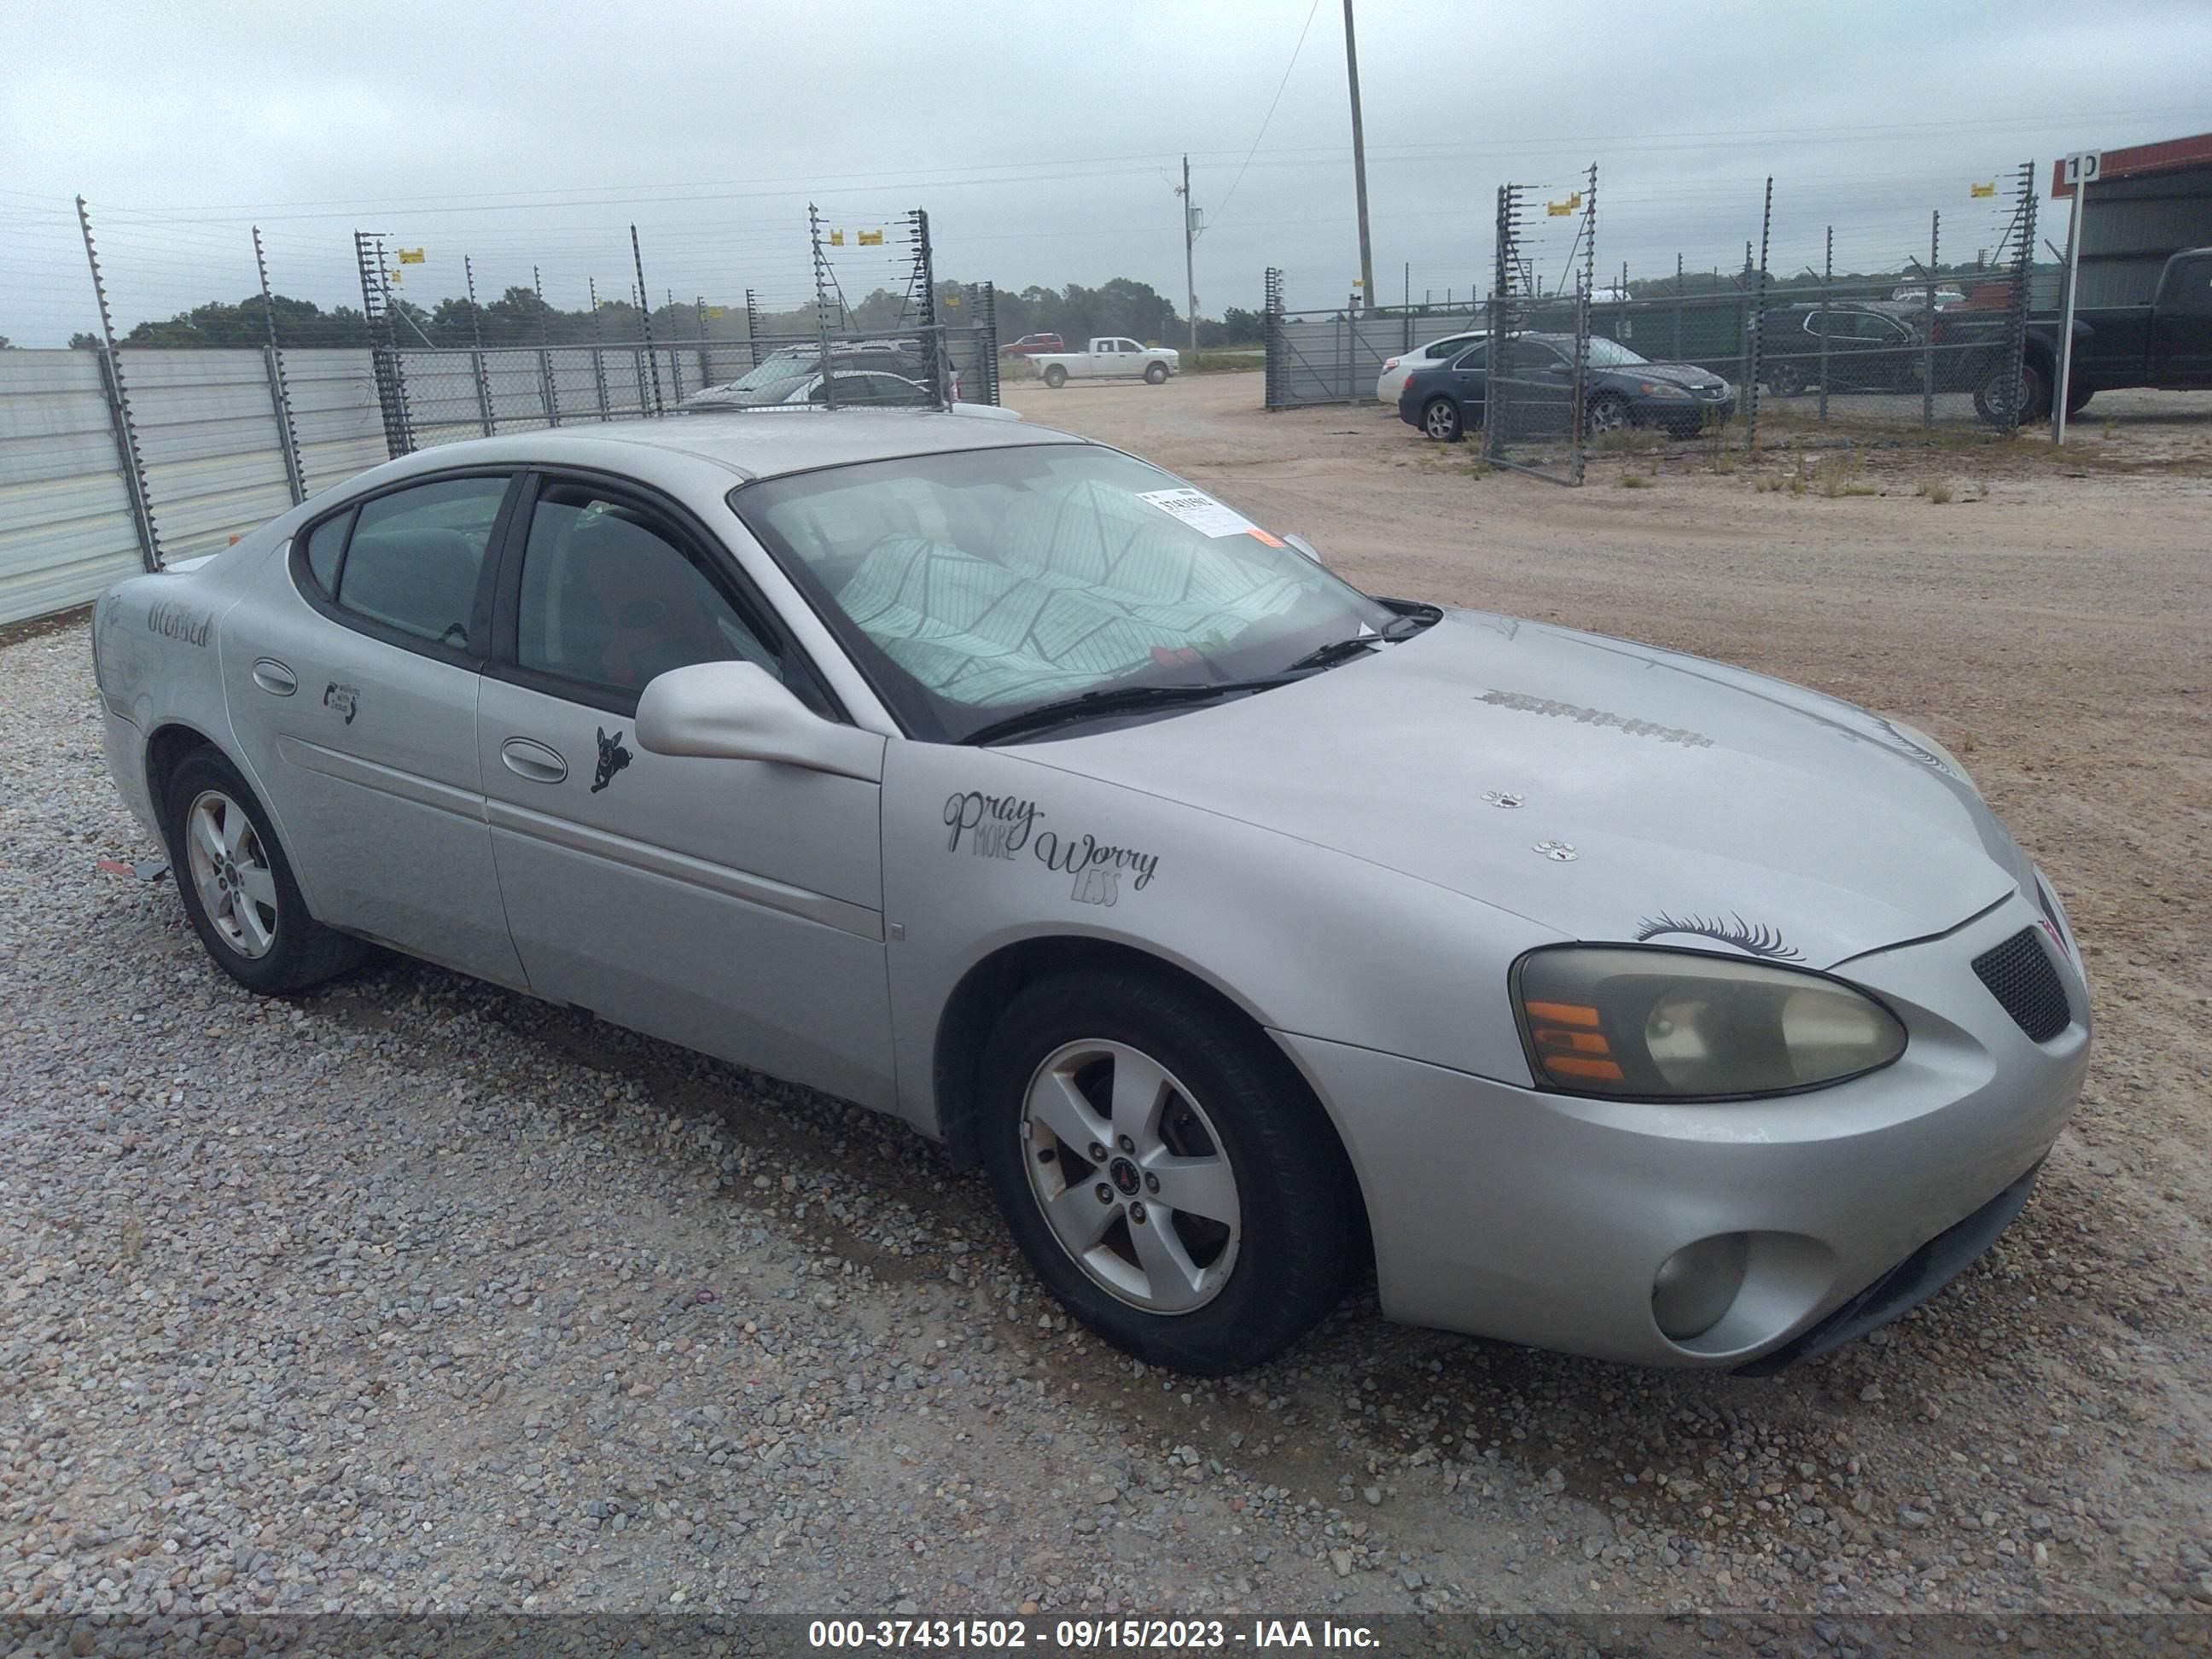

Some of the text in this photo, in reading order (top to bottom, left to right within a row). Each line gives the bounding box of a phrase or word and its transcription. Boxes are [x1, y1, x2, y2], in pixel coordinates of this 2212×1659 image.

[973, 824, 1016, 860] MORE
[1033, 831, 1159, 891] Worry
[1070, 868, 1121, 907] LESS
